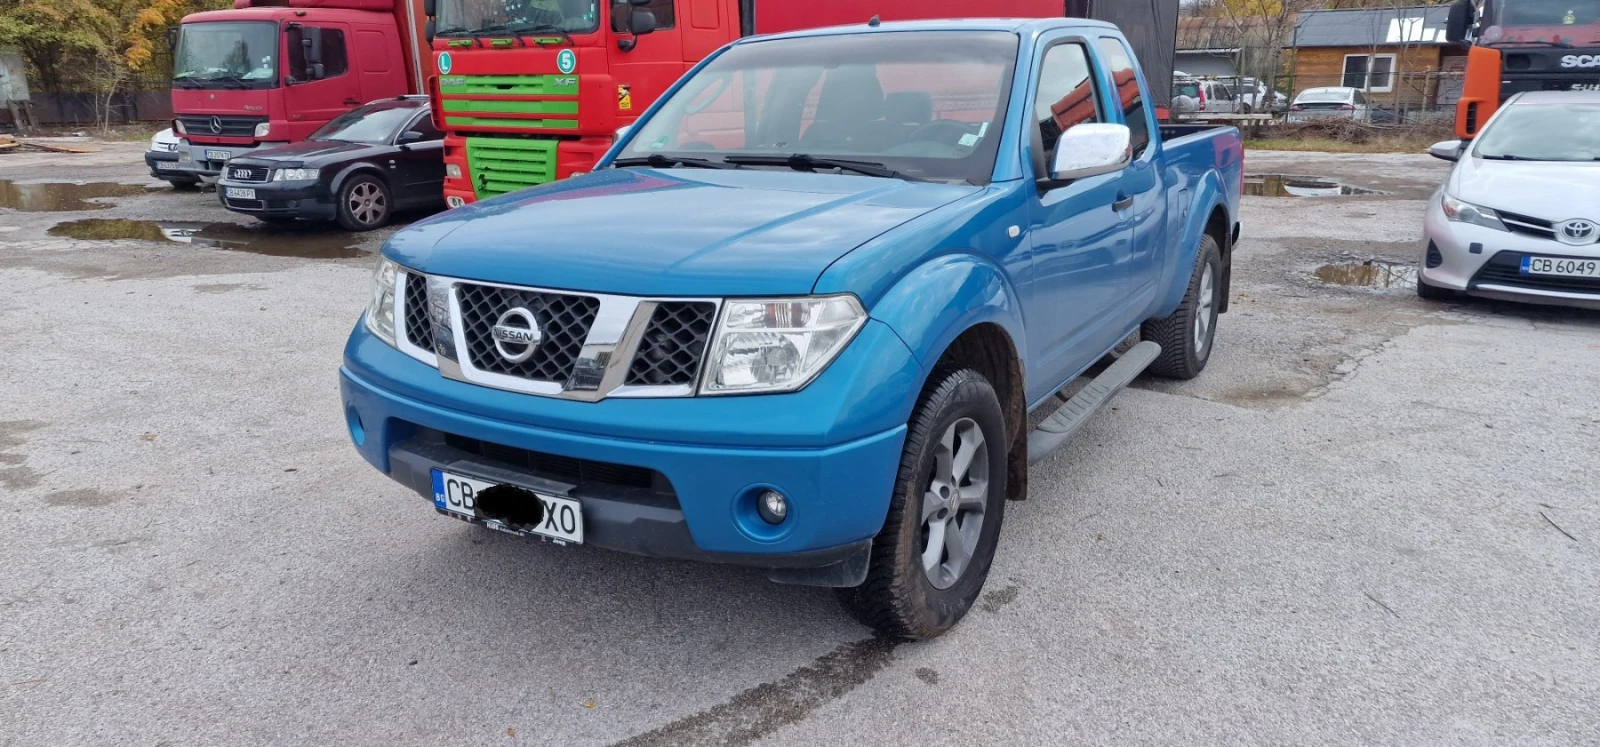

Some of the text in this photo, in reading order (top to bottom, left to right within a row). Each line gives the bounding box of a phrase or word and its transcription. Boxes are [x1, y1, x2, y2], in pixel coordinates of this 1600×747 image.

[441, 55, 448, 71] L
[561, 52, 572, 69] 5
[441, 78, 465, 87] DAF
[553, 78, 576, 86] XF
[1532, 258, 1552, 272] CB
[1556, 260, 1596, 275] 6049
[493, 328, 534, 341] NISSAN
[435, 493, 446, 503] BG
[446, 478, 576, 534] CB XO
